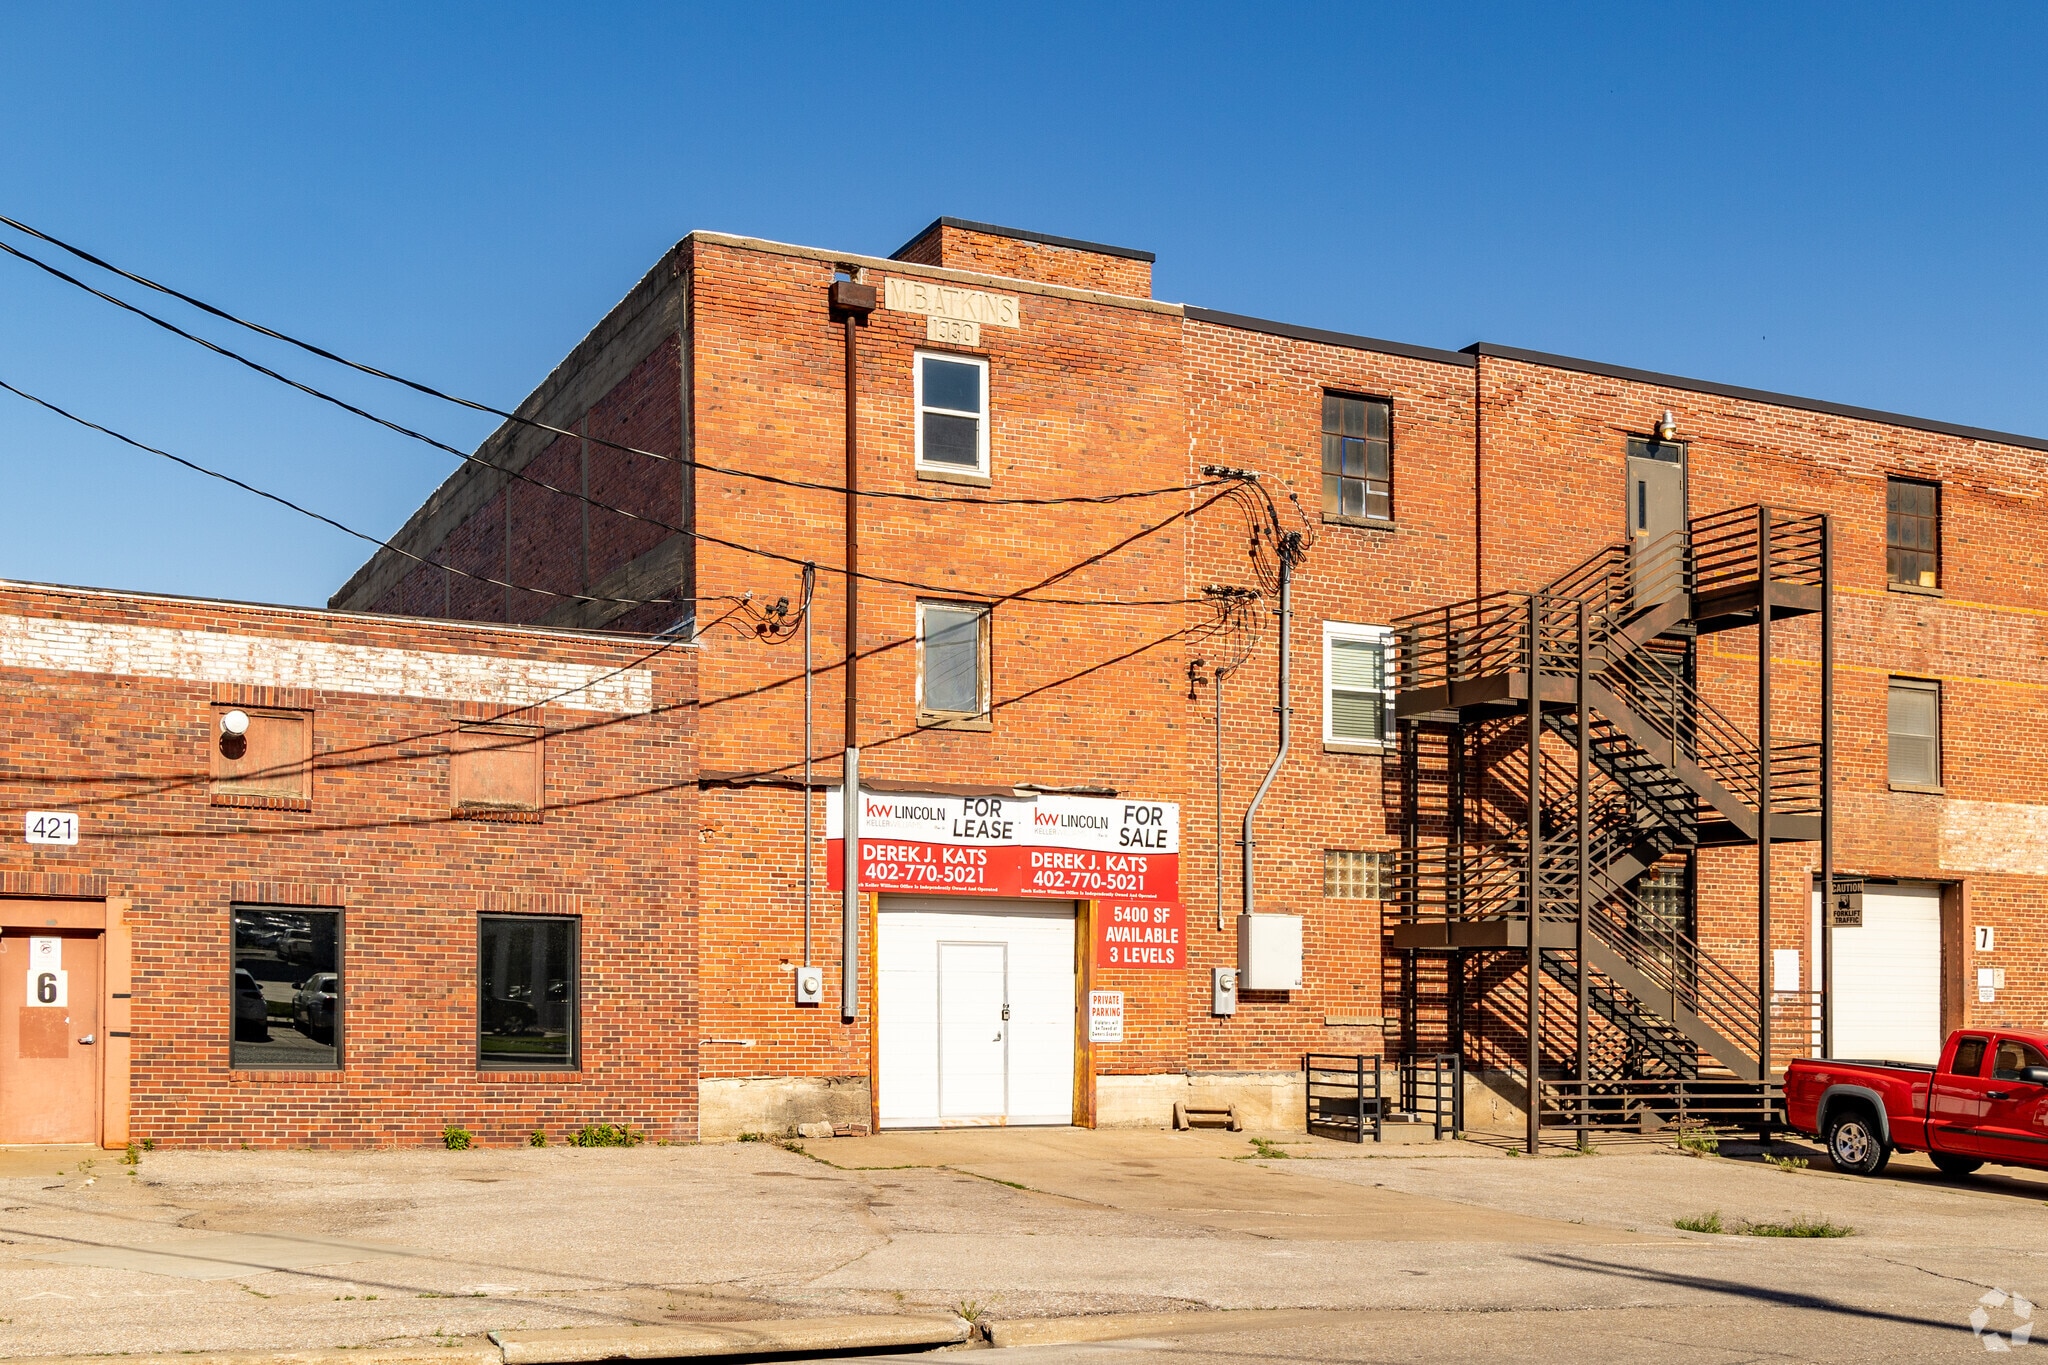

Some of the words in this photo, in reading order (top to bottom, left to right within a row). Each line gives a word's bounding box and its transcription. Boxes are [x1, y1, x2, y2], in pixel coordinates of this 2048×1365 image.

[895, 806, 946, 821] LINCOLN
[963, 798, 1002, 818] FOR
[1123, 805, 1163, 826] FOR
[33, 817, 71, 839] 421
[953, 819, 1014, 840] LEASE
[1061, 814, 1109, 829] LINCOLN
[1119, 827, 1168, 848] SALE
[863, 845, 921, 863] DEREK
[923, 848, 937, 863] J.
[942, 848, 987, 865] KATS
[1031, 852, 1086, 870] DEREK
[1088, 855, 1101, 871] J.
[1106, 855, 1148, 873] KATS
[865, 863, 984, 883] 402-770-5021
[1033, 871, 1145, 891] 402-770-5021
[1832, 883, 1862, 893] CAUTION
[1114, 906, 1149, 922] 5400
[1153, 907, 1171, 924] SF
[1105, 926, 1179, 944] AVAILABLE
[1981, 928, 1988, 948] 7
[1109, 946, 1119, 963] 3
[1123, 947, 1175, 964] LEVELS
[37, 972, 57, 1004] 6
[1093, 995, 1120, 1005] PRIVATE
[1092, 1007, 1121, 1017] PARKING
